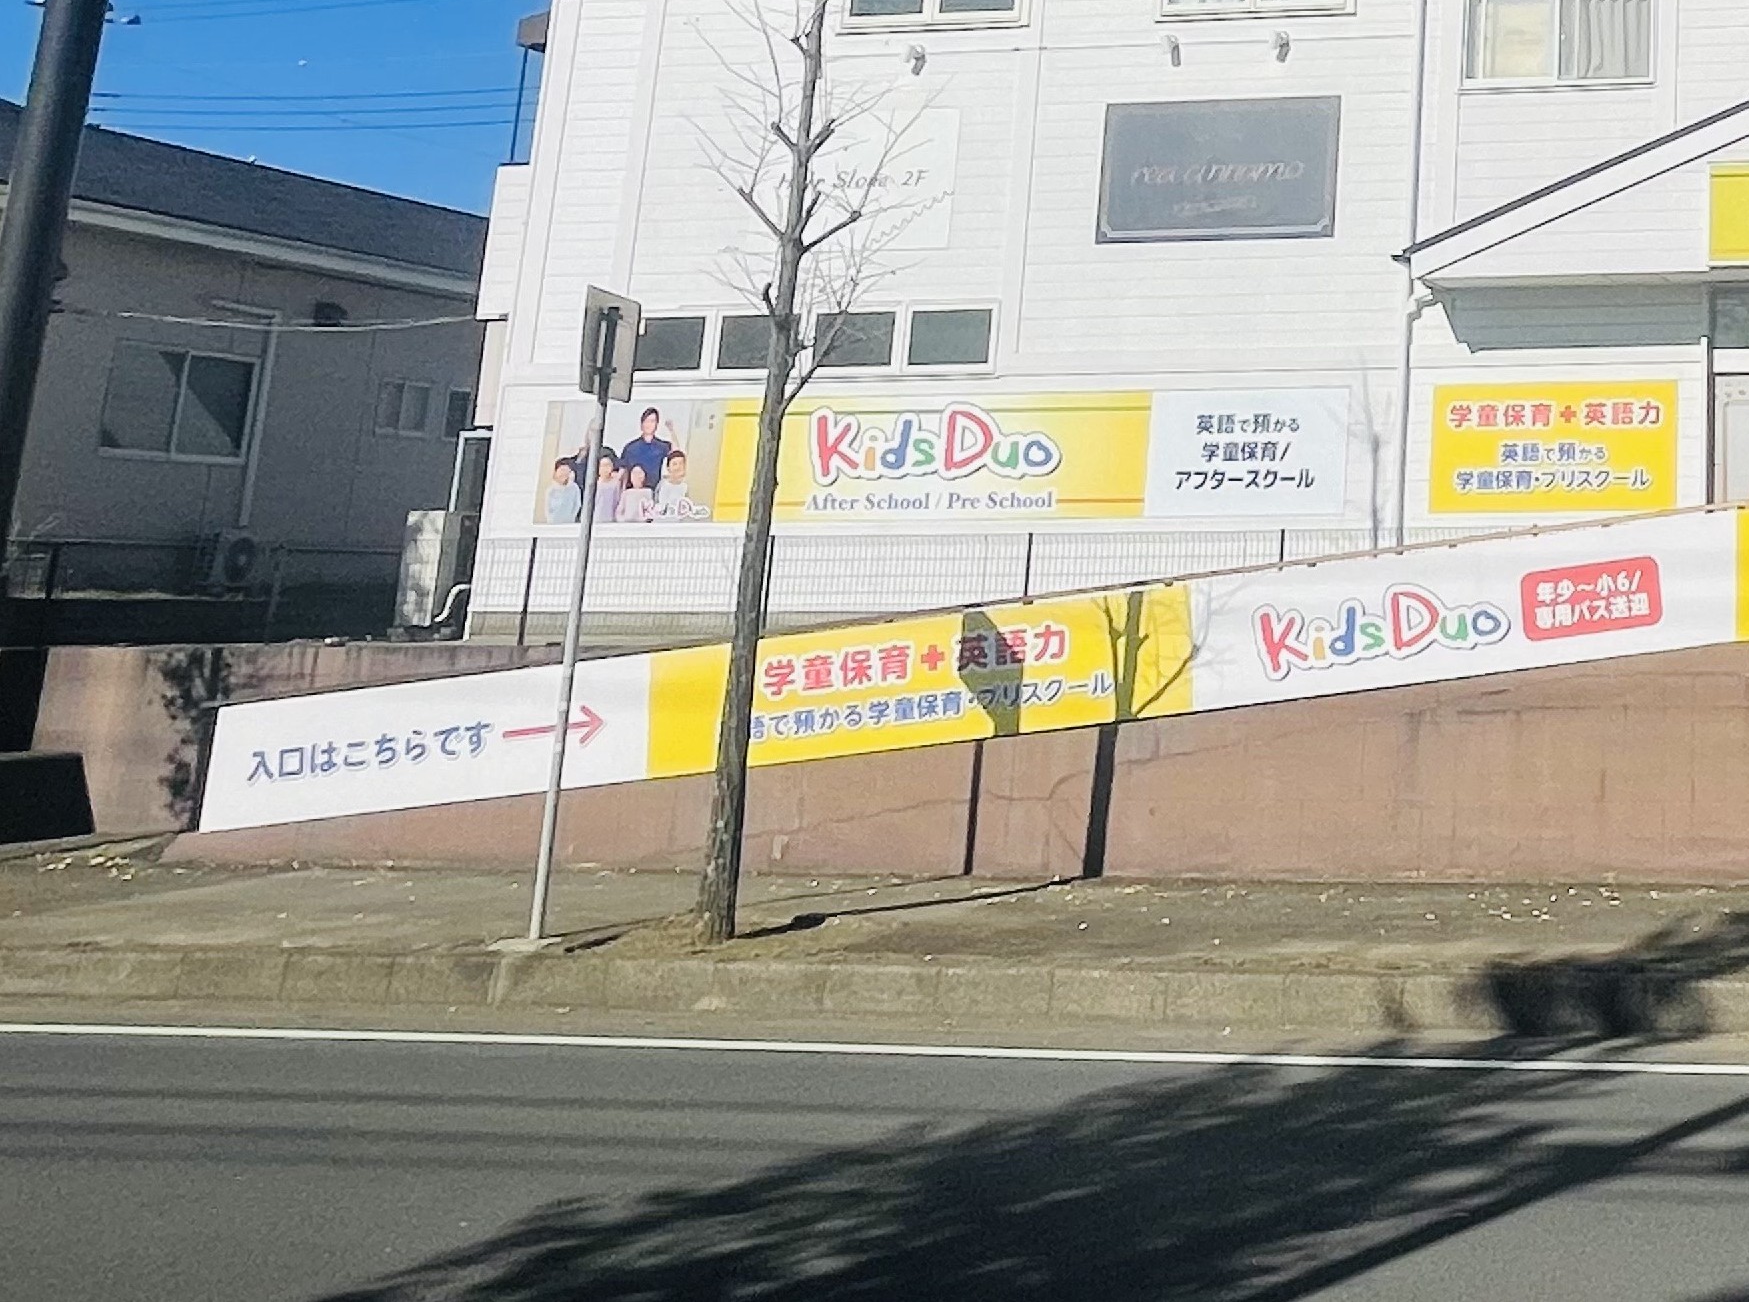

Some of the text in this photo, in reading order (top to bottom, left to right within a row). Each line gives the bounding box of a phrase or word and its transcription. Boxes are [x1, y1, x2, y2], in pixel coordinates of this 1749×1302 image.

[901, 170, 930, 187] 2F
[1196, 413, 1300, 435] 英語で預かる
[816, 409, 1054, 478] KidsDuo
[1501, 442, 1606, 462] 英語で預かる
[1175, 469, 1315, 490] アフタースクール
[807, 493, 859, 511] After
[864, 492, 930, 511] School
[946, 492, 981, 510] Pre
[985, 491, 1053, 510] School
[1258, 590, 1502, 673] KidsDuo
[246, 720, 492, 783] 入口はこちらです
